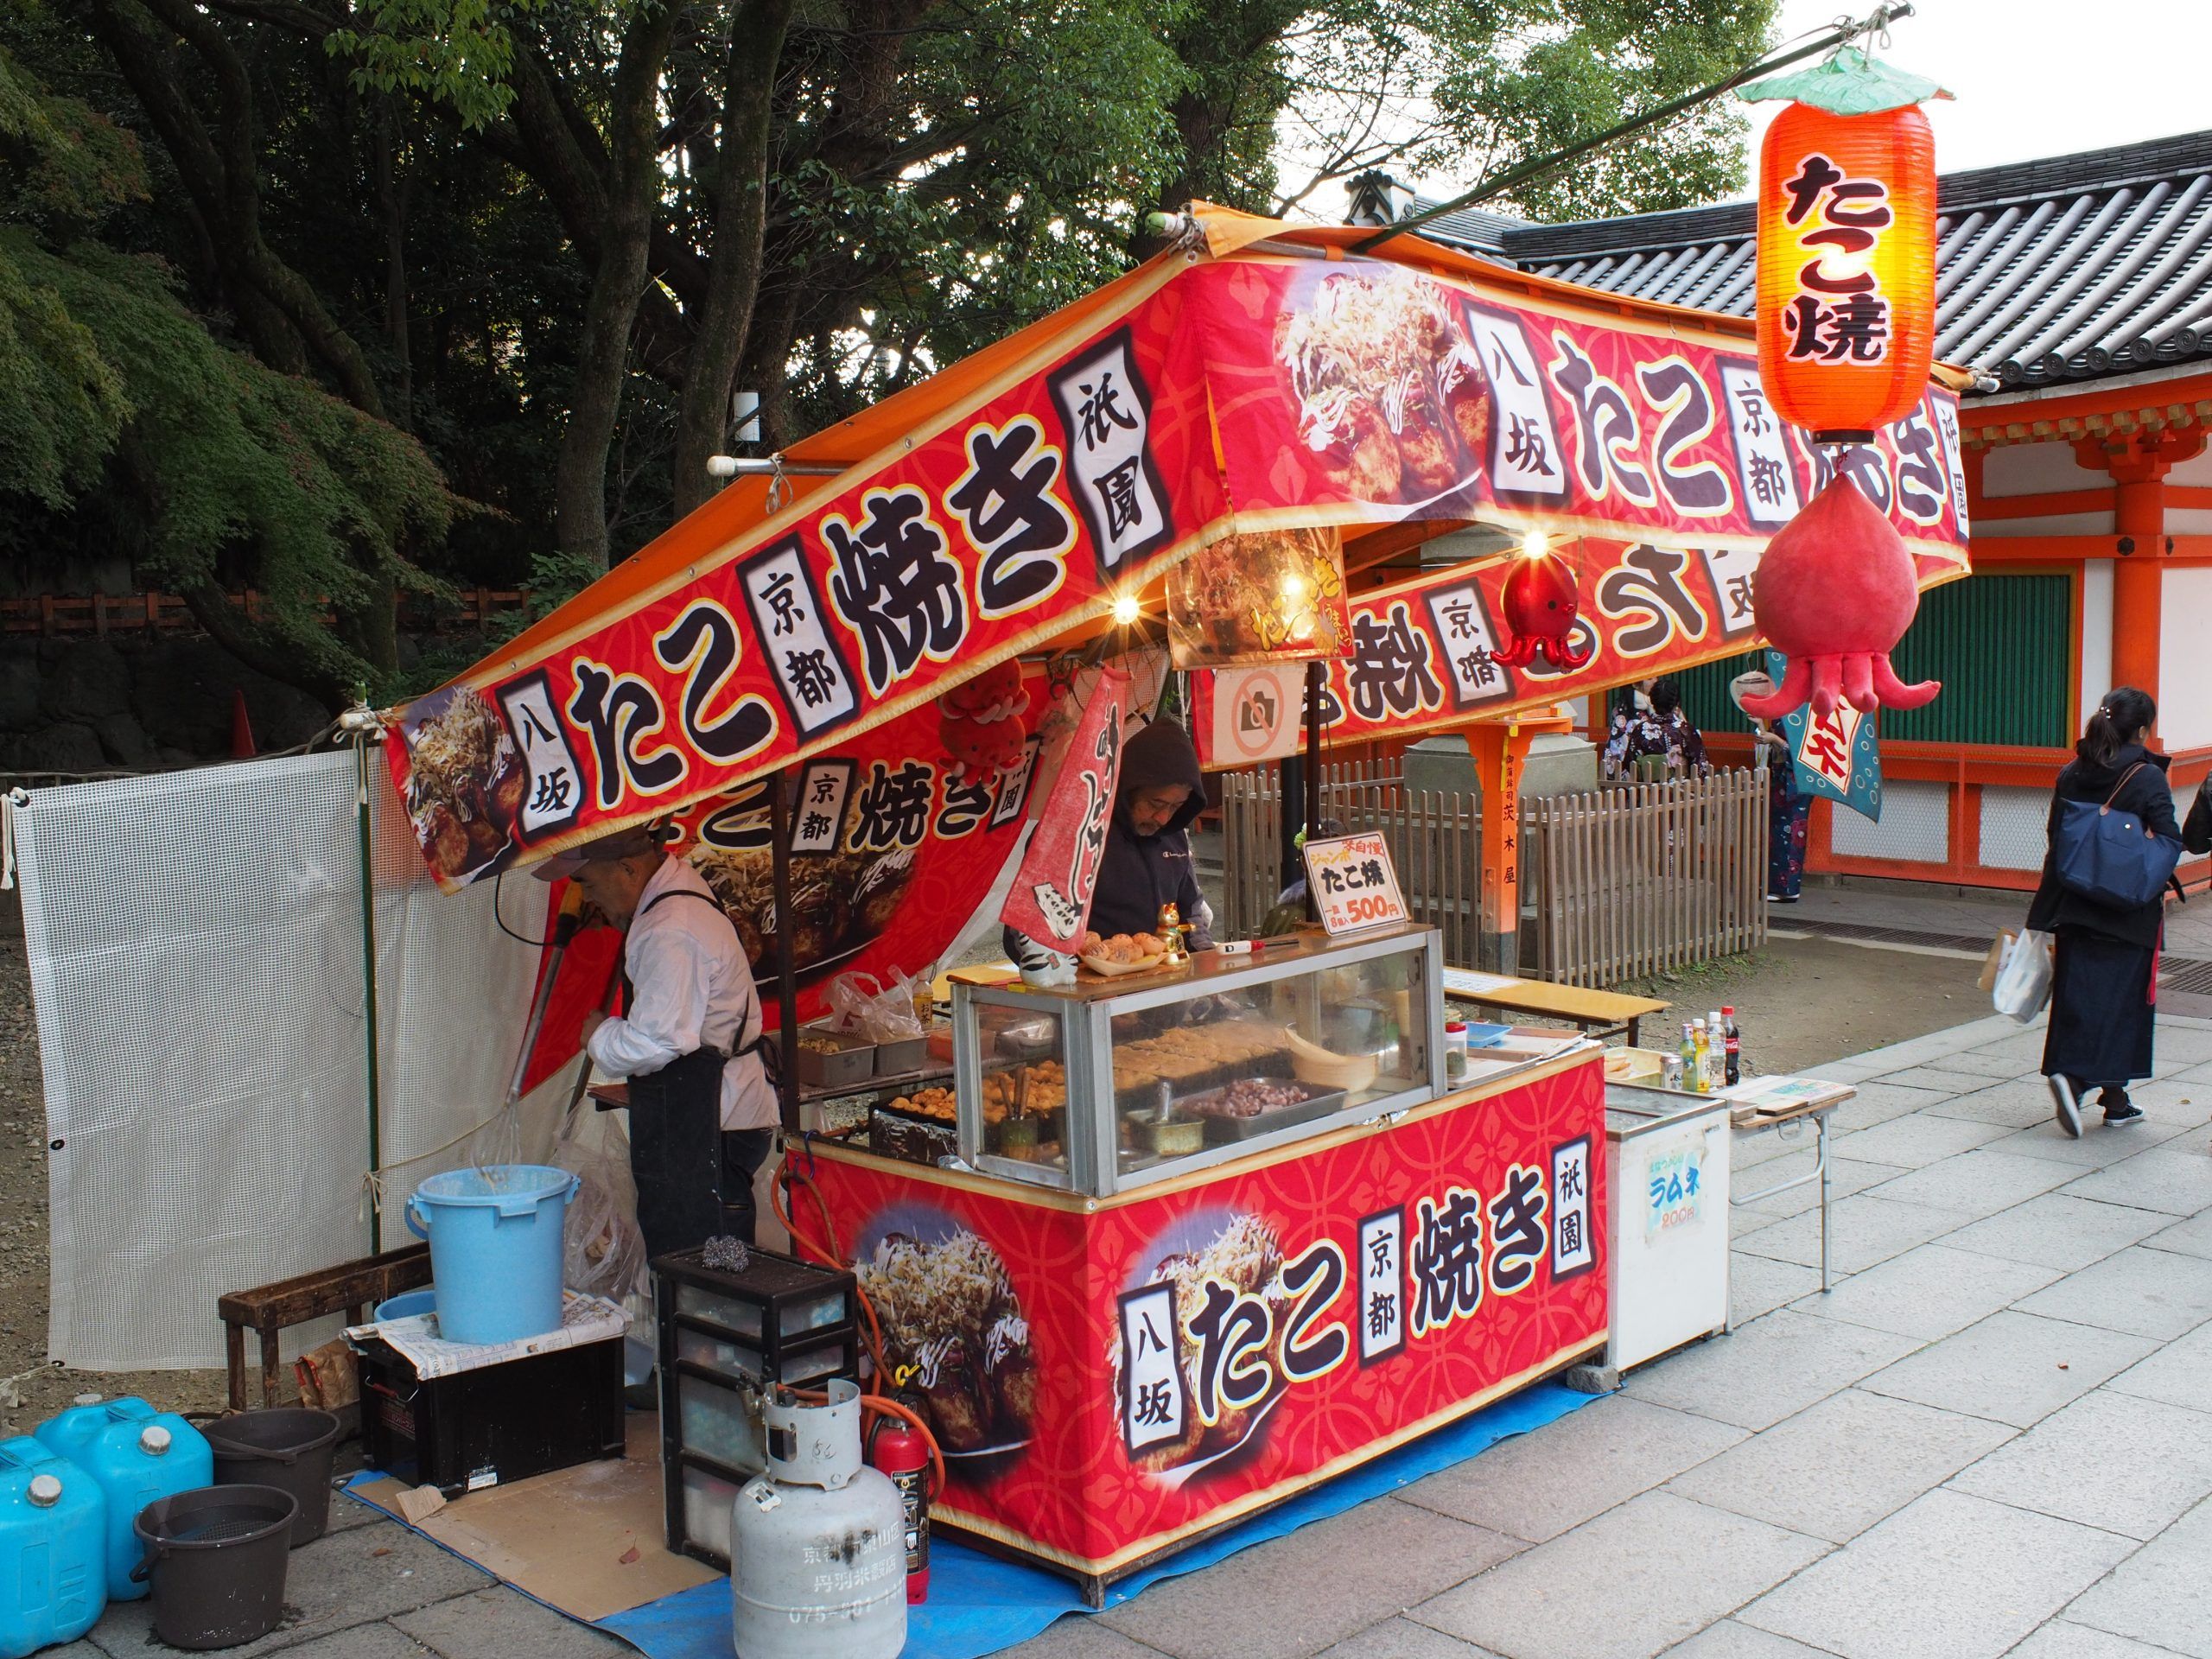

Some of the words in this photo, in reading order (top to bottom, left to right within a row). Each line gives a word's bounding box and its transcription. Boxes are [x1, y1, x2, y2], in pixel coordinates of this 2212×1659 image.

[1784, 152, 1894, 364] たこ焼
[1490, 330, 1555, 476] 八坂
[1549, 330, 1734, 517] たこ
[1735, 379, 1786, 507] 京都
[520, 702, 571, 814] 八坂
[567, 599, 777, 810] たこ
[757, 571, 838, 712] 京都
[823, 416, 1076, 698] 焼き
[1078, 374, 1141, 543] 祇園
[799, 773, 840, 842] 京都
[1321, 859, 1385, 894] たこ焼
[1503, 804, 1516, 884] 茨木屋
[1346, 894, 1400, 924] 500円
[920, 1003, 931, 1025] お茶
[1649, 1166, 1700, 1208] ラムネ
[1662, 1206, 1694, 1230] 200円
[1133, 1309, 1173, 1427] 八坂
[1186, 1238, 1349, 1427] たこ
[1365, 1230, 1396, 1339] 京都
[1411, 1164, 1551, 1336] 焼き
[1558, 1158, 1585, 1260] 祇園
